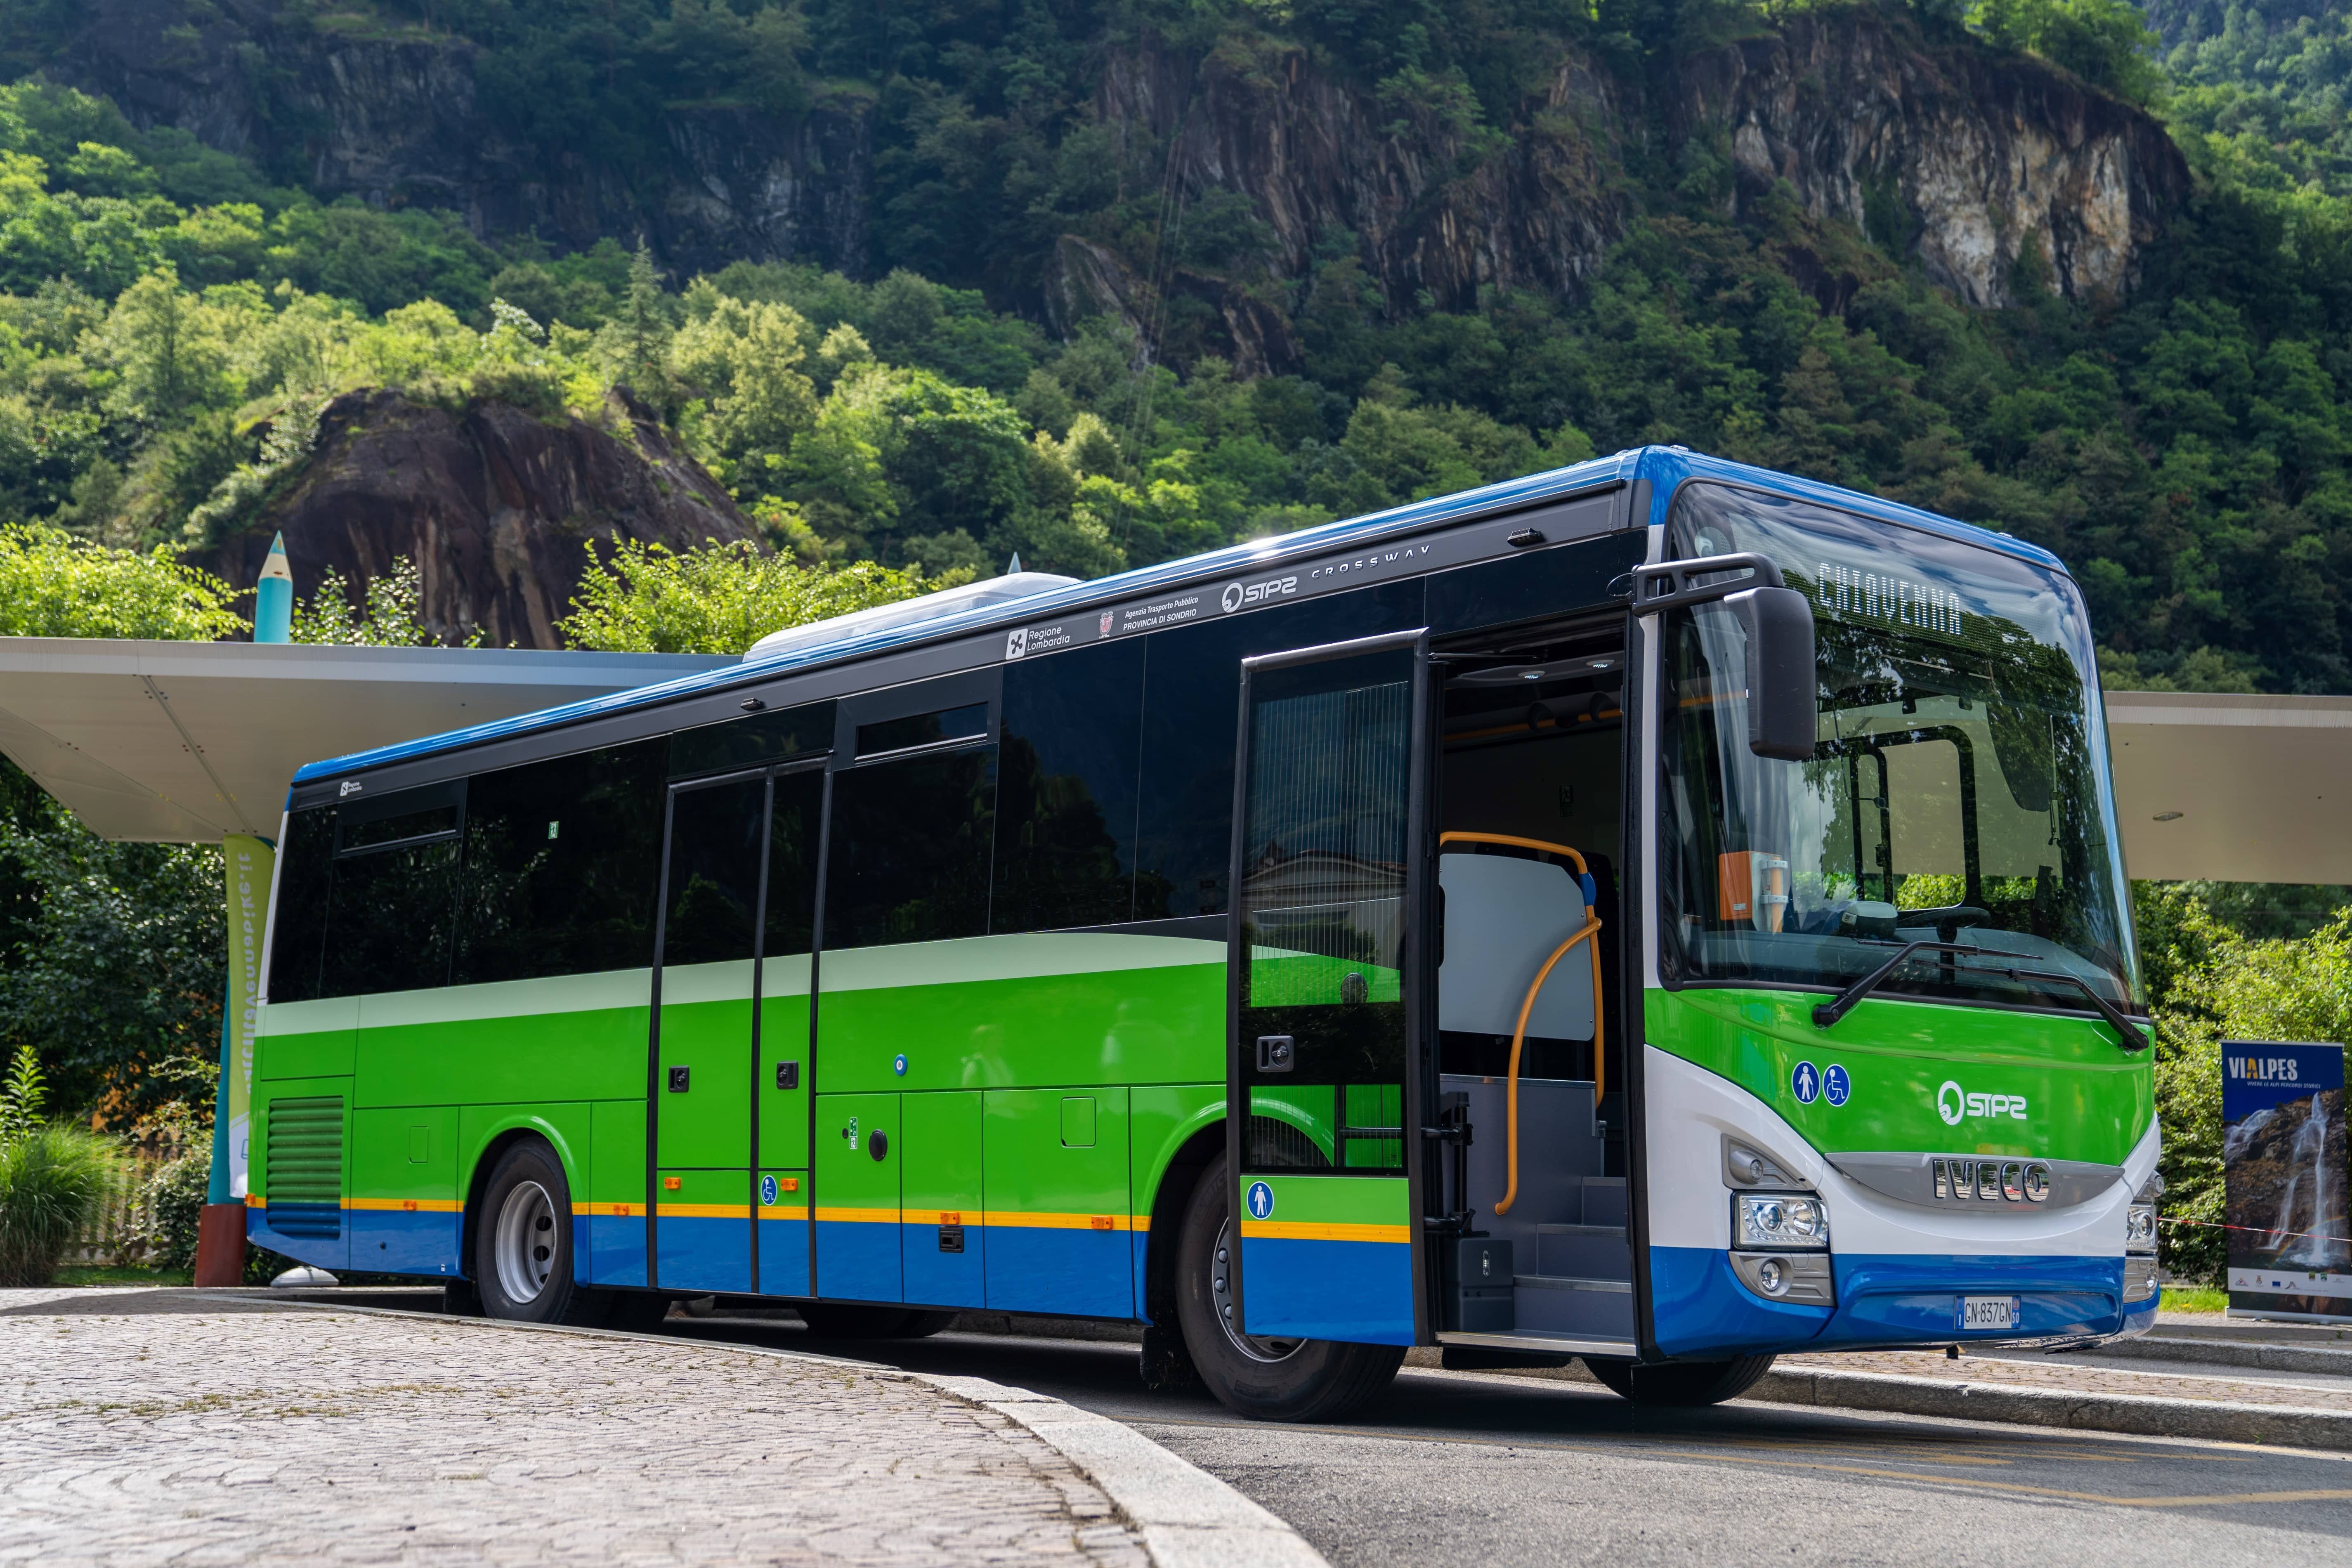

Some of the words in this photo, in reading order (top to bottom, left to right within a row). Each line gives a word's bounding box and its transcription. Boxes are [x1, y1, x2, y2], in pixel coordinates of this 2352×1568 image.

[1125, 607, 1146, 619] Agenzia
[1148, 602, 1173, 613] Trasporto
[1174, 597, 1198, 607] Pubblico
[1819, 562, 1961, 635] CHIAVENNA
[1123, 617, 1157, 631] PROVINCIA
[1159, 615, 1166, 623] DI
[1167, 609, 1197, 621] SONDRIO
[1027, 635, 1070, 651] Lombardia
[1029, 627, 1062, 640] Regione
[2229, 1057, 2298, 1081] VIALPES
[1933, 1159, 2049, 1202] IVECO
[2012, 1312, 2019, 1324] SO
